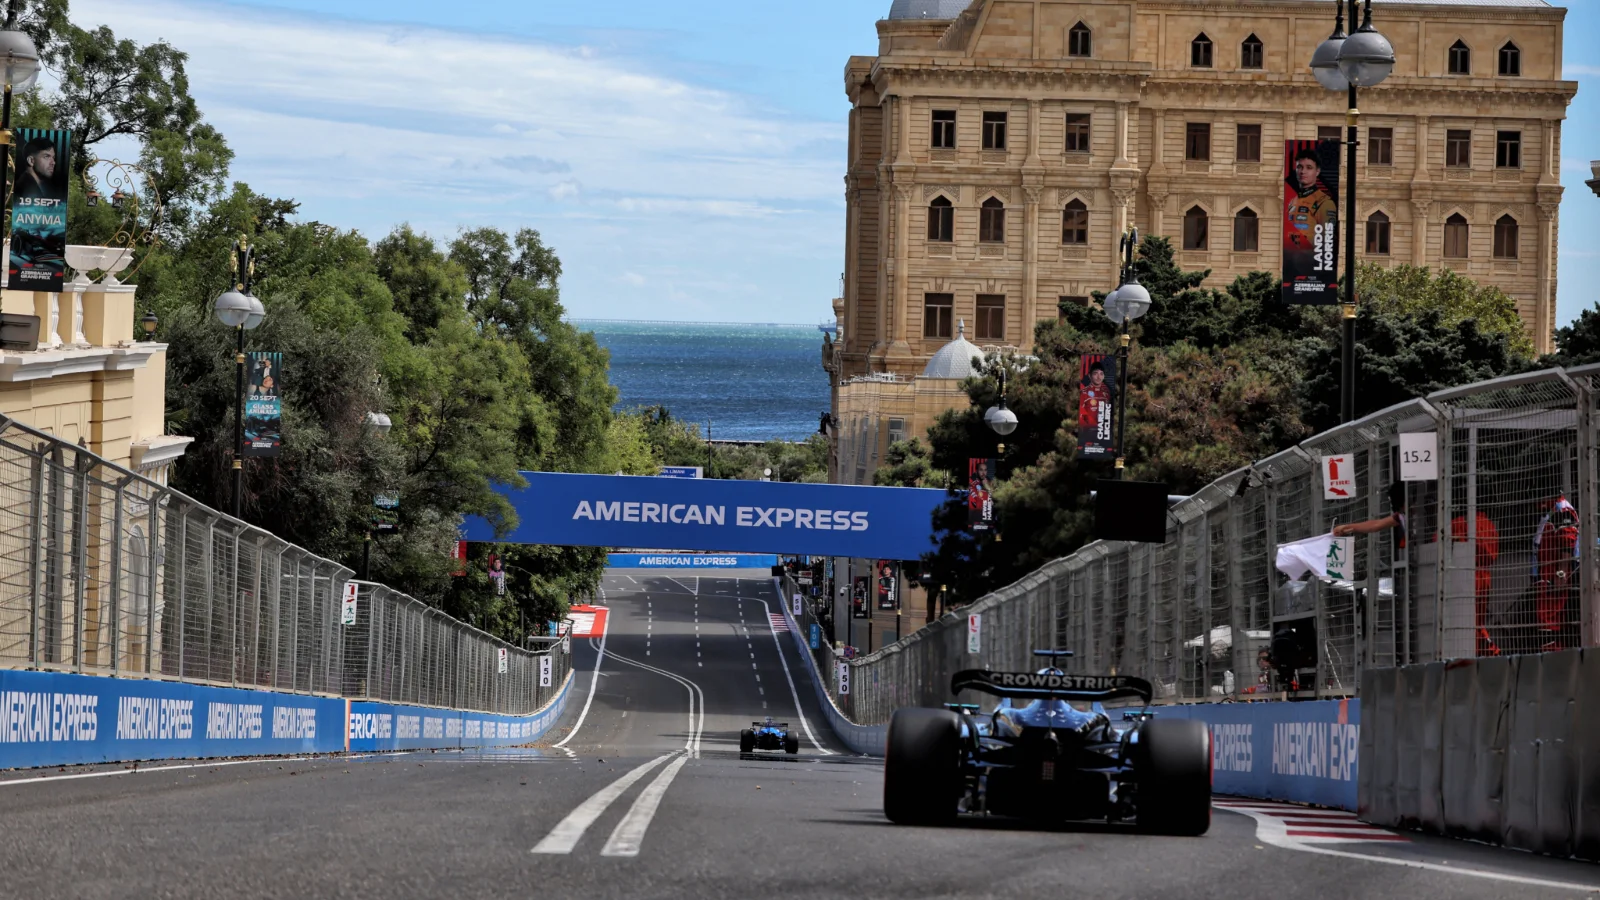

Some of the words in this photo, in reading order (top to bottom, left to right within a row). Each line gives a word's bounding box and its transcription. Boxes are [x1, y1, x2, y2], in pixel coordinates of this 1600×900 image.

[16, 213, 62, 225] ANYMA
[19, 197, 31, 206] 19
[34, 198, 61, 207] SEPT
[1314, 224, 1323, 270] LANDO
[1324, 222, 1333, 271] NORRIS
[1404, 450, 1432, 463] 15.2
[572, 500, 725, 526] AMERICAN
[736, 506, 869, 531] EXPRESS
[639, 557, 690, 565] AMERICAN
[693, 557, 737, 565] EXPRESS
[795, 599, 799, 610] 50
[990, 673, 1126, 689] CROWDSTRIKE
[0, 691, 50, 743] MERICAN
[52, 693, 98, 741] EXPRESS
[116, 696, 159, 739] AMERICAN
[160, 699, 193, 739] EXPRESS
[206, 702, 237, 739] AMERICAN
[238, 704, 262, 739] EXPRESS
[1214, 724, 1252, 772] EXPRESS
[1272, 722, 1327, 778] AMERICAN
